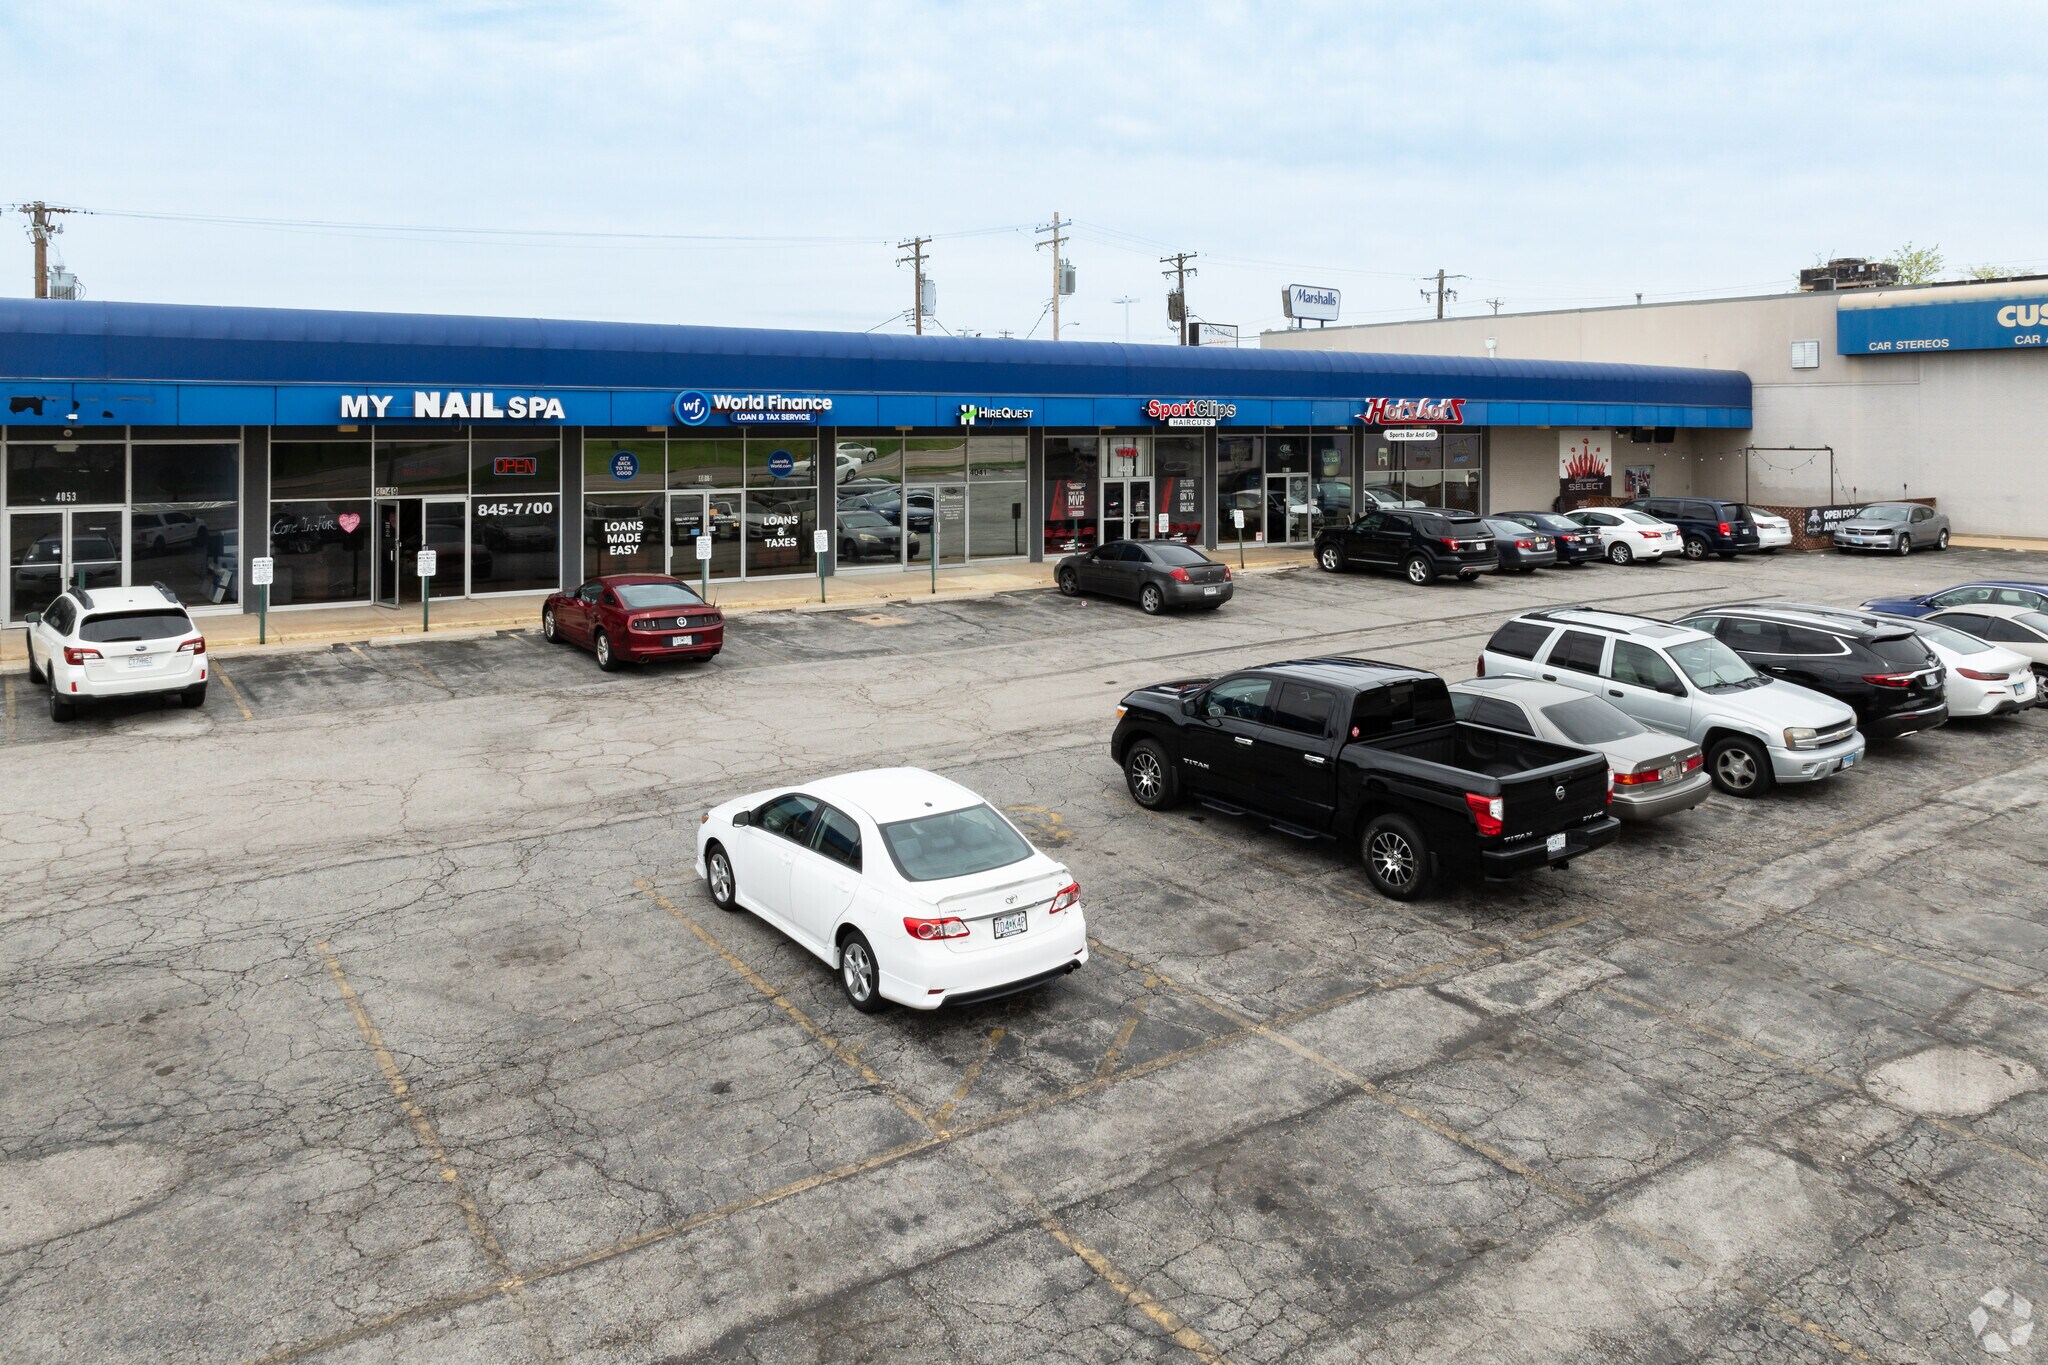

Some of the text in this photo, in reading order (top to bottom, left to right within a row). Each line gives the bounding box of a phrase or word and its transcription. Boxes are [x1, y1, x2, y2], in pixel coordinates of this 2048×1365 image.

[1294, 289, 1336, 306] Marshalls
[1869, 338, 1950, 351] CAR STEREOS
[2014, 334, 2041, 345] CAR
[340, 391, 565, 419] MY NAIL SPA
[713, 394, 832, 410] World Finance
[737, 413, 811, 421] LOAN & TAX SERVICE
[495, 458, 535, 474] OPEN
[1118, 465, 1135, 473] 4037
[970, 468, 987, 476] 4041
[1568, 482, 1604, 491] SELECT
[55, 491, 77, 502] 4053
[1068, 495, 1085, 506] MVP
[763, 515, 798, 526] LOANS
[1823, 510, 1842, 520] OPEN
[604, 521, 644, 532] LOANS
[777, 527, 785, 536] &
[1823, 521, 1838, 531] AND
[607, 533, 641, 543] MADE
[764, 538, 797, 548] TAXES
[609, 545, 639, 555] EASY
[1183, 757, 1209, 769] TITAN
[1504, 831, 1533, 843] TITAN
